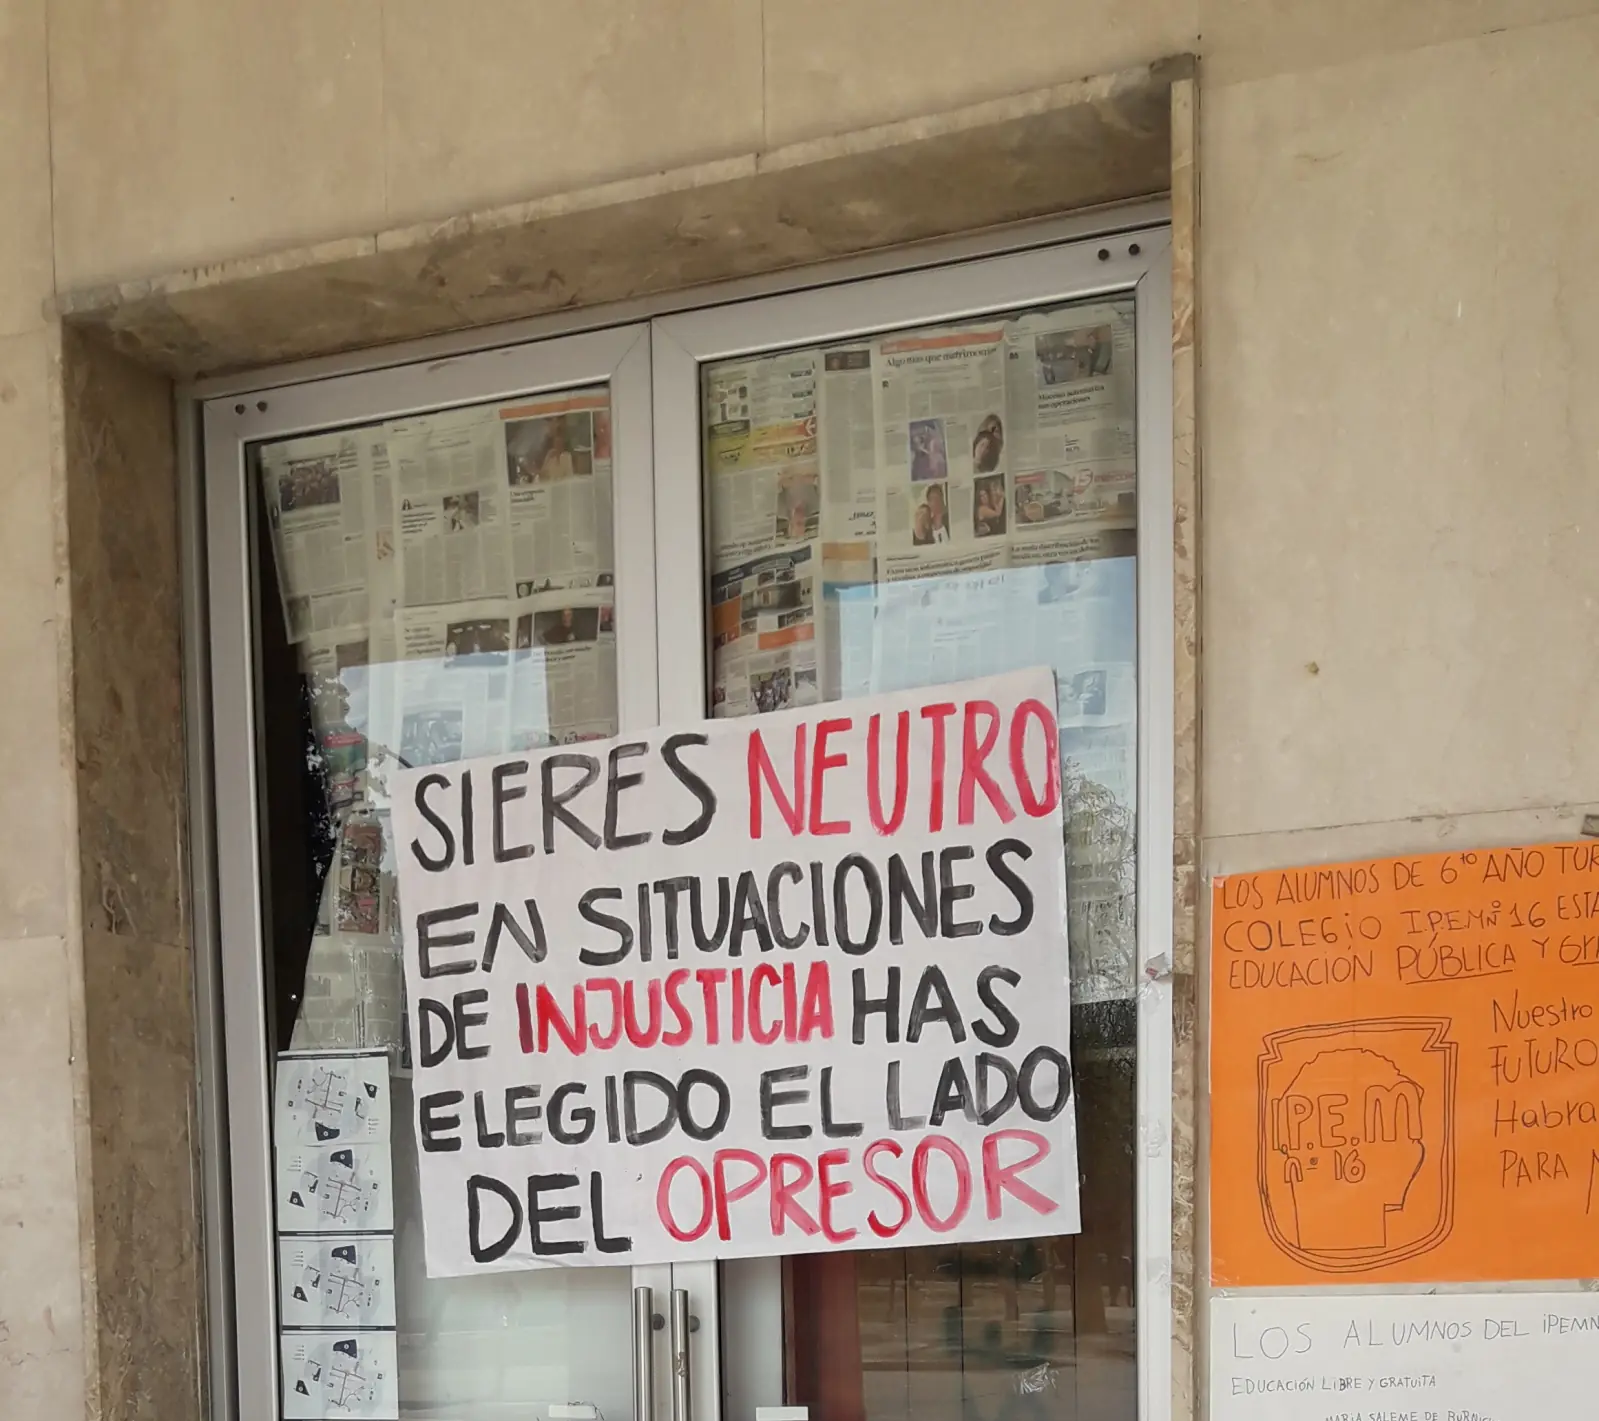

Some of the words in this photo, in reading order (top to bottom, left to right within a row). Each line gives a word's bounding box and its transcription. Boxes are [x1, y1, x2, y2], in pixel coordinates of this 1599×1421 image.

[747, 698, 1062, 839] NEUTRO
[1223, 875, 1264, 910] LOS
[1276, 863, 1380, 905] ALUMNOS
[1394, 861, 1424, 891] DE
[1482, 848, 1545, 883] AÑO
[417, 899, 548, 980] EN
[579, 838, 1034, 966] SITUACIONES
[1510, 901, 1546, 928] 16
[1396, 932, 1516, 980] PÚBLICA
[1532, 936, 1550, 958] Y
[418, 989, 490, 1068] DE
[516, 960, 834, 1057] INJUSTICIA
[851, 964, 1022, 1048] HAS
[1493, 989, 1593, 1033] Nuestro
[1488, 1037, 1598, 1087] FUTURO
[422, 1068, 731, 1152] ELEGIDO
[760, 1064, 864, 1142] EL
[886, 1045, 1072, 1132] LADO
[1334, 1149, 1366, 1183] 16
[1500, 1149, 1569, 1188] PARA
[467, 1170, 632, 1263] DEL
[655, 1129, 1061, 1244] OPRESOR
[1233, 1323, 1312, 1359] LOS
[1343, 1319, 1473, 1349] ALUMNOS
[1484, 1319, 1530, 1340] DEL
[1231, 1375, 1315, 1396] EDUCACIÓN
